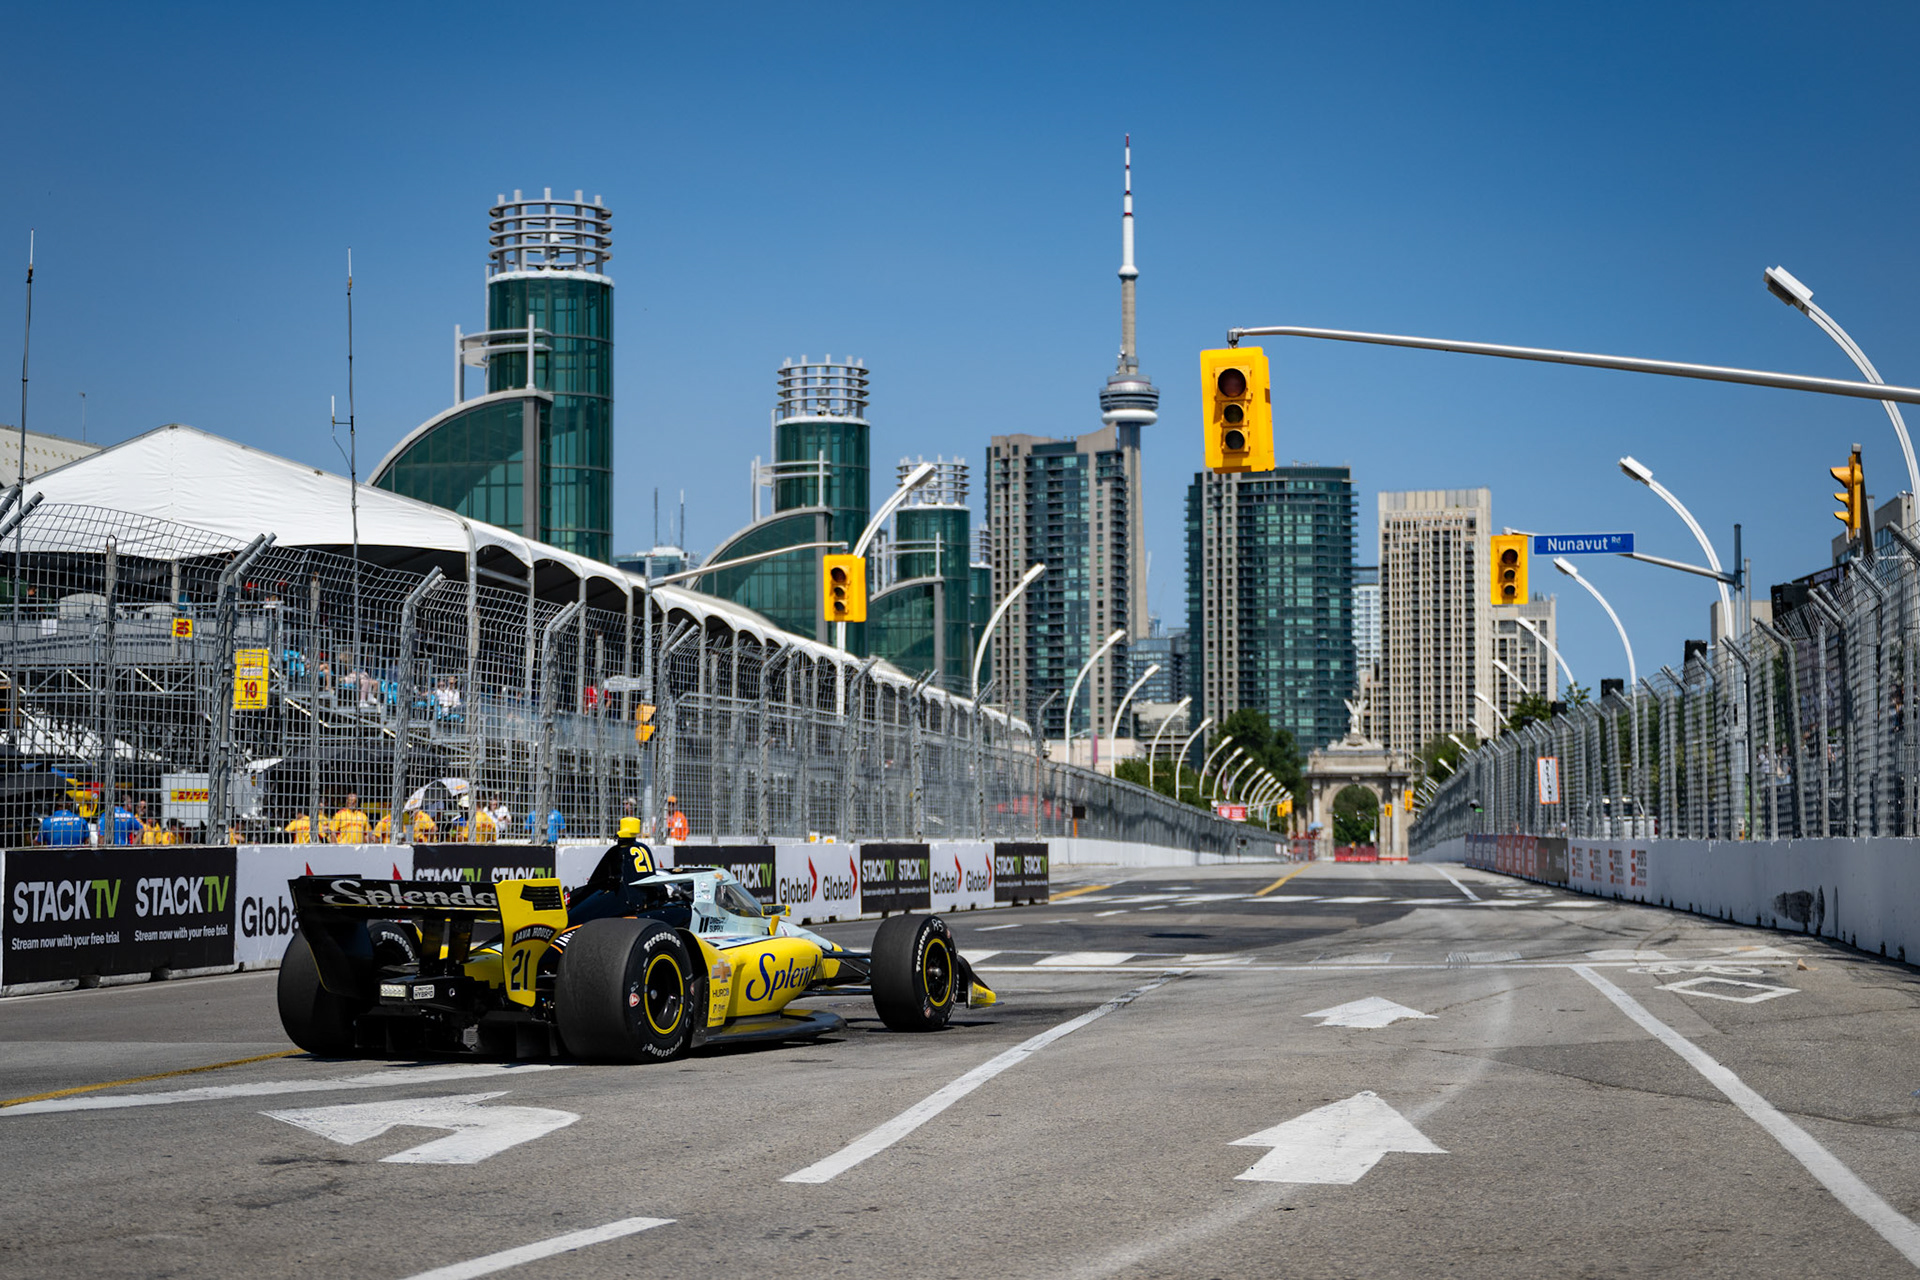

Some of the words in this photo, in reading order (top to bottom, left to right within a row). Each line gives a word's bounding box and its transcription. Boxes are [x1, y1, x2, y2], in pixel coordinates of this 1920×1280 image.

[1547, 537, 1608, 551] Nunavut
[176, 621, 190, 635] 10
[244, 681, 258, 699] 10
[630, 846, 653, 873] 21
[862, 859, 895, 883] STACKTV
[898, 858, 929, 881] STACKTV
[322, 879, 498, 907] Splenda
[779, 878, 811, 904] Global
[823, 876, 852, 901] Global
[932, 871, 958, 894] Global
[966, 870, 988, 893] Global
[13, 879, 121, 924] STACKTV
[134, 876, 229, 917] STACKTV
[241, 896, 300, 938] Globa
[11, 937, 39, 951] Stream
[40, 938, 56, 949] now
[56, 934, 73, 947] with
[73, 936, 91, 949] your
[90, 932, 105, 945] free
[105, 931, 120, 943] trial
[134, 930, 158, 942] Stream
[159, 930, 173, 940] now
[173, 927, 188, 938] with
[188, 928, 203, 941] your
[203, 925, 216, 937] free
[215, 924, 228, 936] trial
[514, 929, 531, 944] JAVA
[531, 927, 554, 941] HOUSE
[643, 932, 681, 952] Firestone
[510, 948, 531, 991] 21
[745, 953, 819, 1002] Splend
